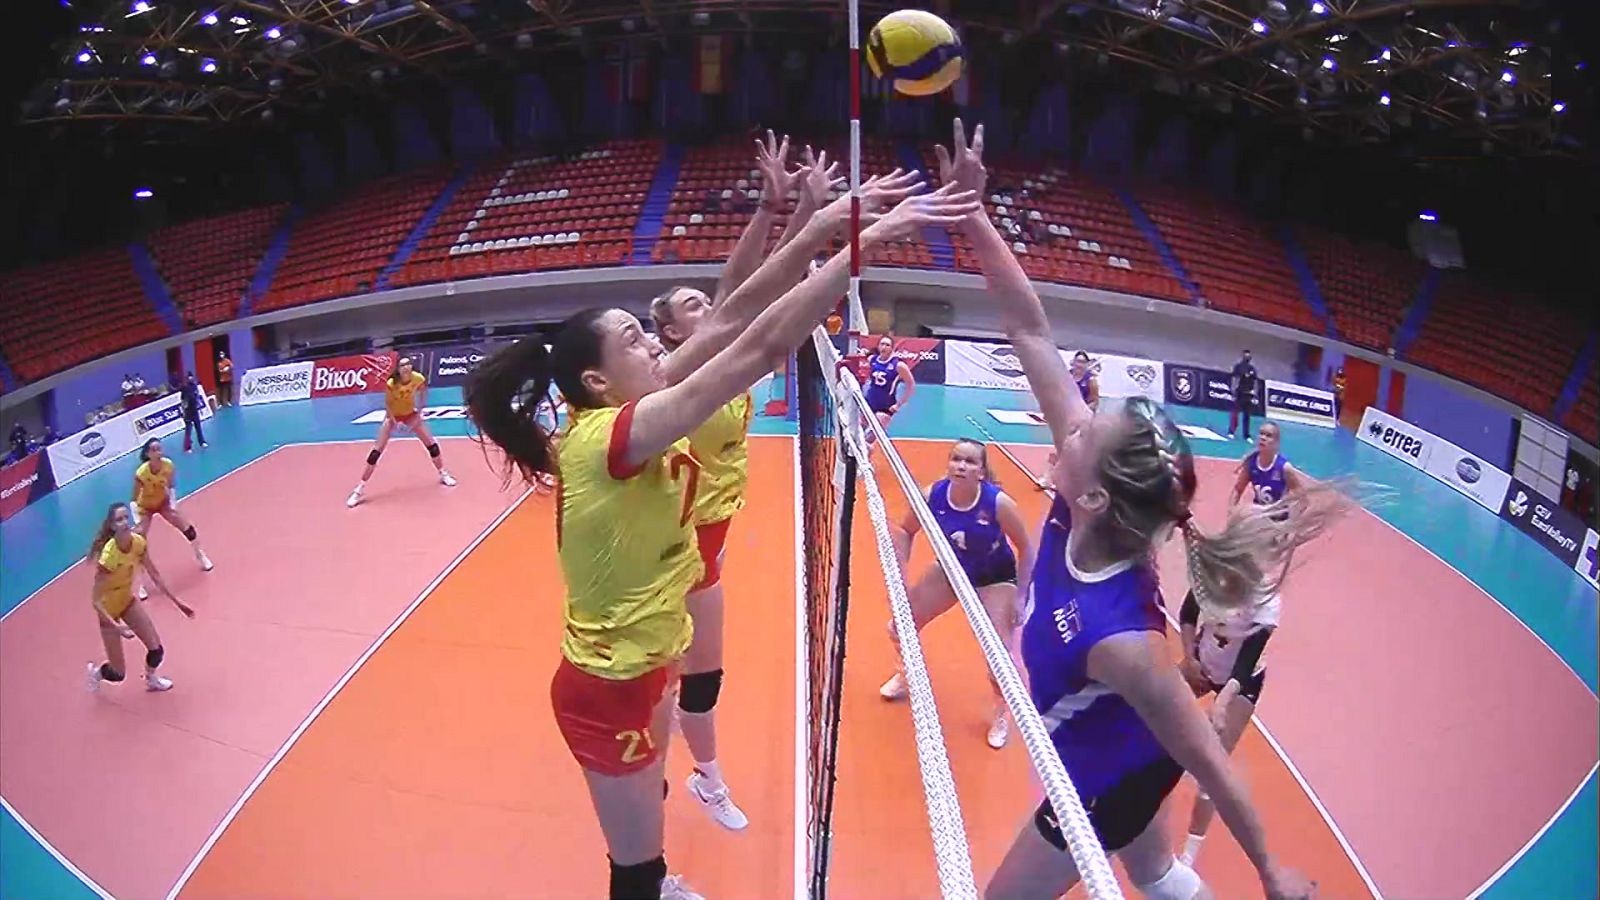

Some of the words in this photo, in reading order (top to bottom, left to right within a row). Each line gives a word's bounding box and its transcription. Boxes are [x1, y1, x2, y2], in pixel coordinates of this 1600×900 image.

[439, 356, 468, 365] Poland,
[919, 351, 939, 361] 2021
[256, 370, 309, 386] HERBALIFE
[872, 371, 887, 386] 15
[254, 380, 309, 395] NUTRITION
[1254, 484, 1273, 504] 16
[1534, 504, 1552, 520] CEV
[1052, 608, 1073, 644] NOR
